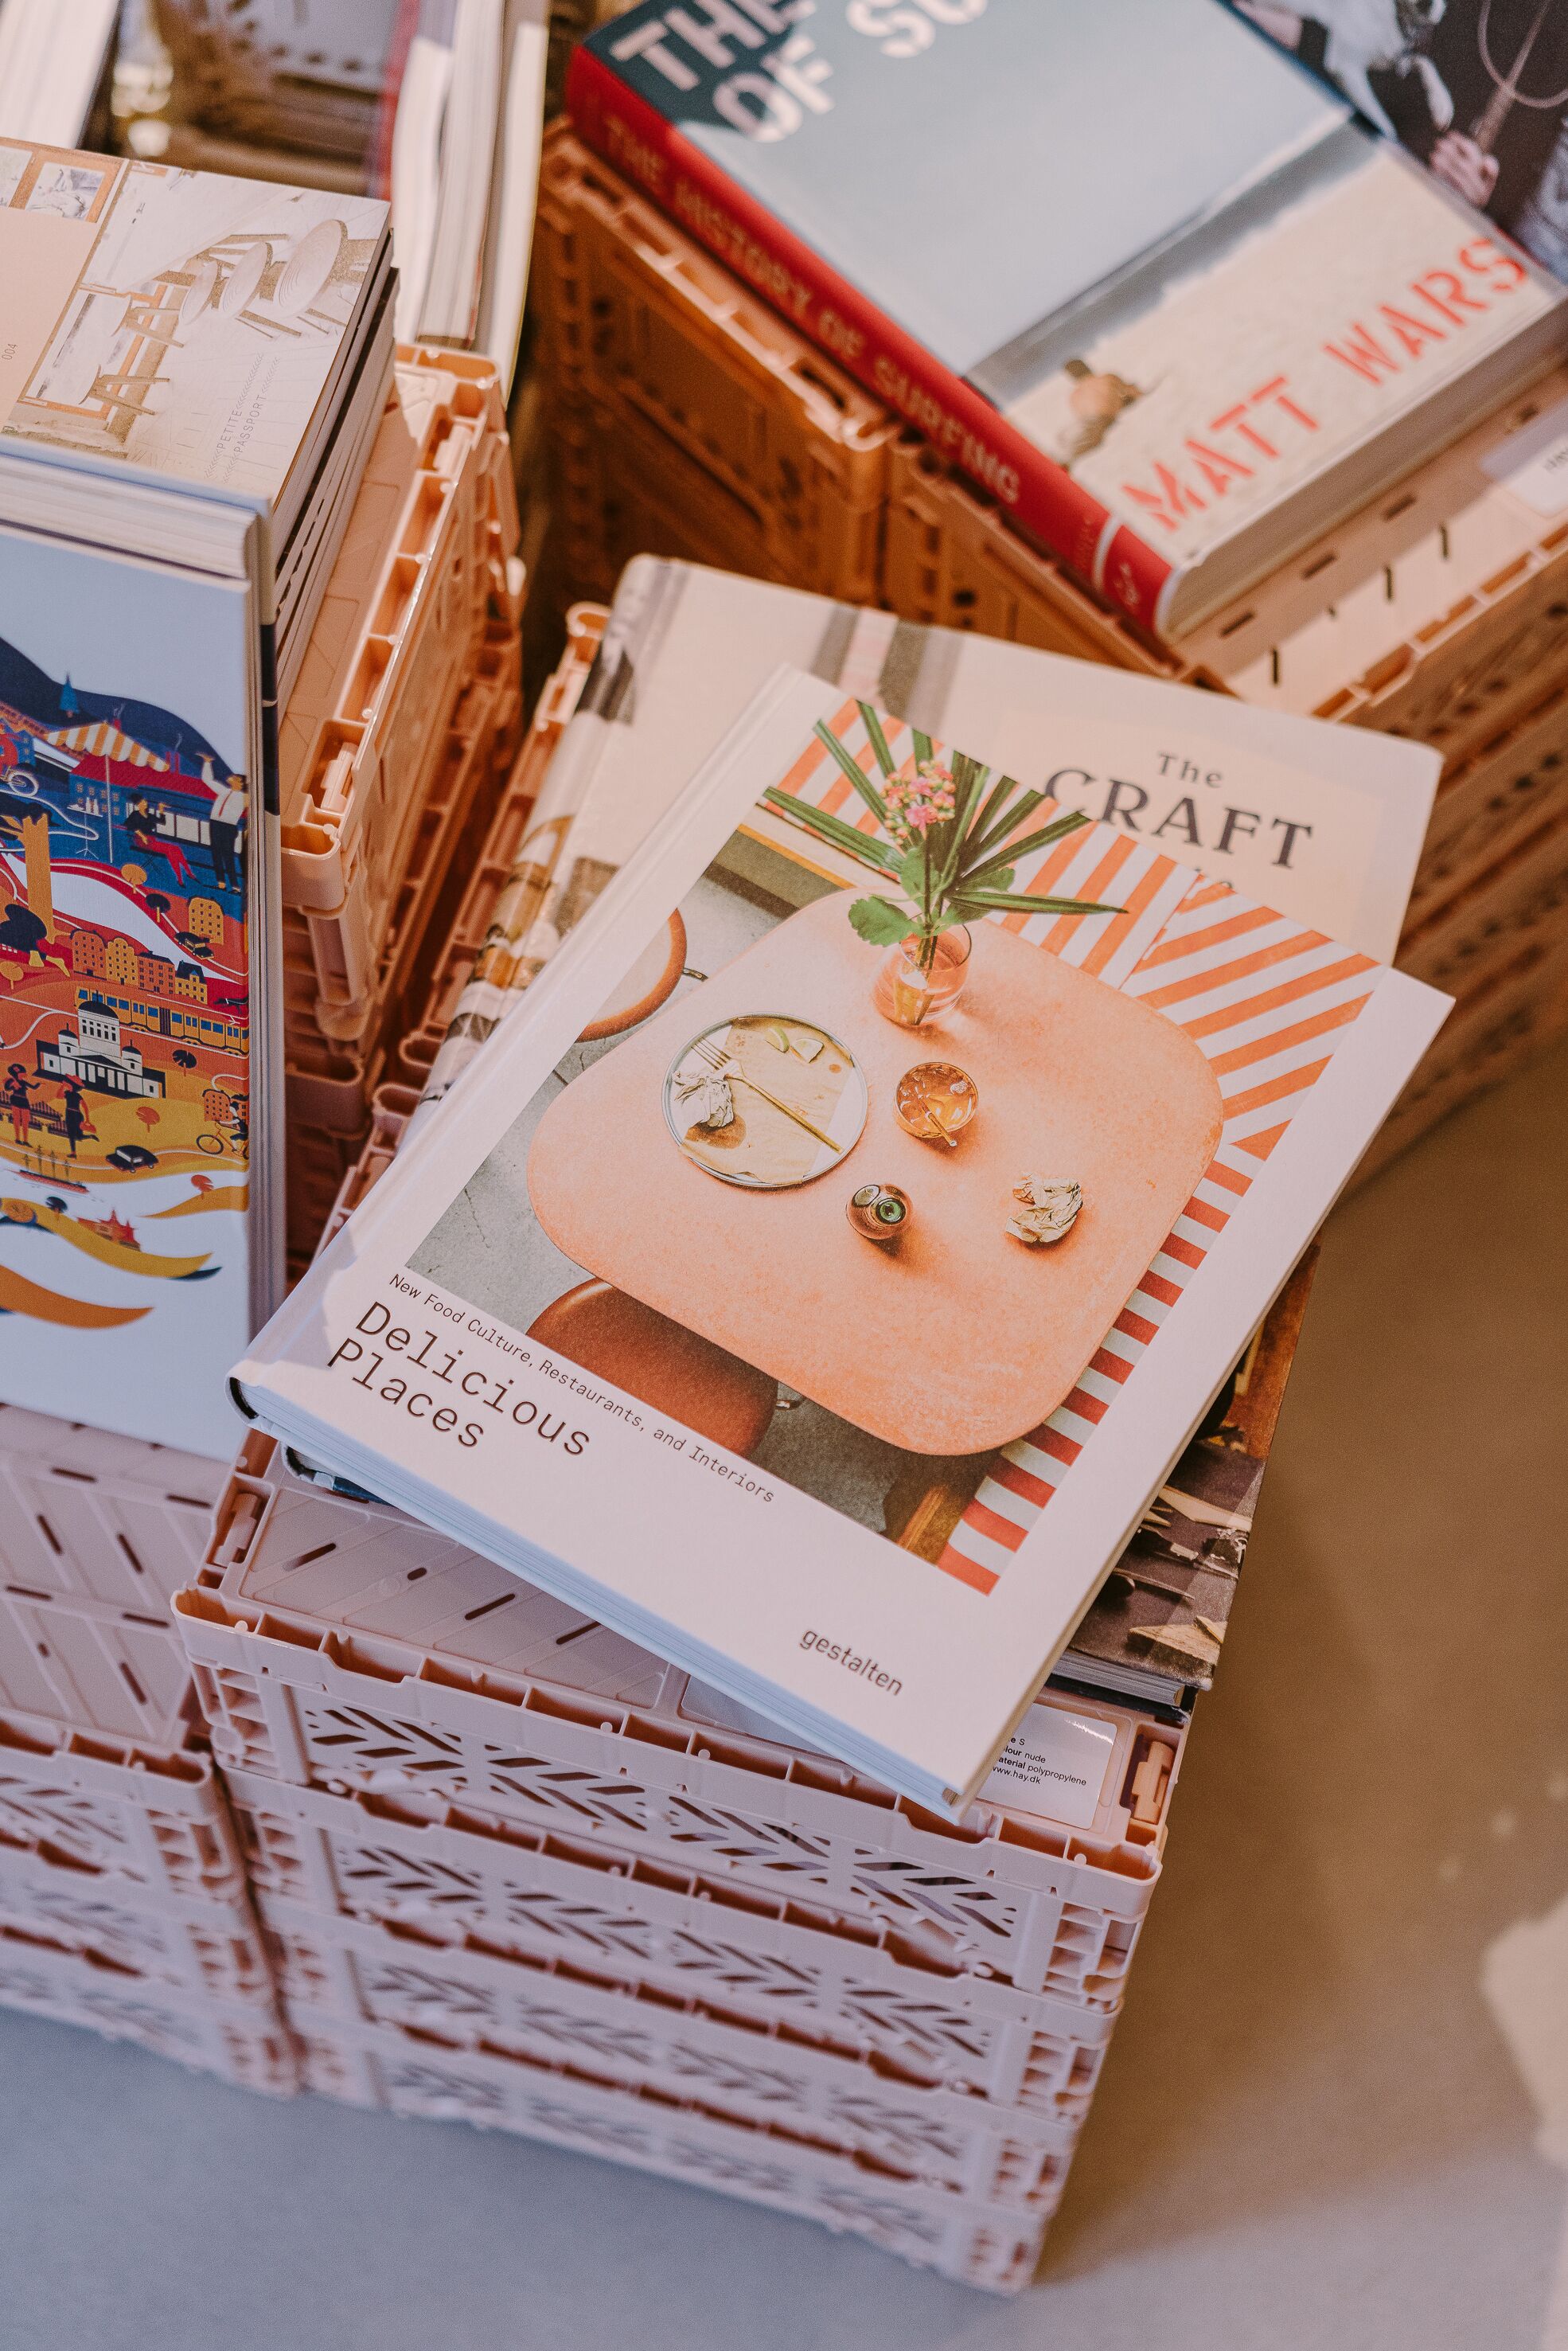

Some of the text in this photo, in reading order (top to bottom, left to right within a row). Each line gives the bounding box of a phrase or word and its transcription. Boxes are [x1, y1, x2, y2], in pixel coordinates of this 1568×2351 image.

[713, 35, 833, 143] OF
[607, 114, 1020, 505] THE HISTORY OF SURFING
[2, 343, 18, 360] 004
[1121, 238, 1527, 532] MATT WARS
[216, 409, 243, 451] PETITE
[233, 394, 267, 453] PASSPORT
[1157, 751, 1223, 789] The
[1043, 769, 1313, 869] CRAFT
[326, 1337, 484, 1448] Places
[355, 1301, 590, 1456] Delicious
[388, 1273, 774, 1503] New Food Culture, Restaurants, and Interiors
[799, 1630, 903, 1697] gestalten
[998, 1755, 1087, 1786] aterial polypropylene
[1004, 1745, 1046, 1763] lour nude
